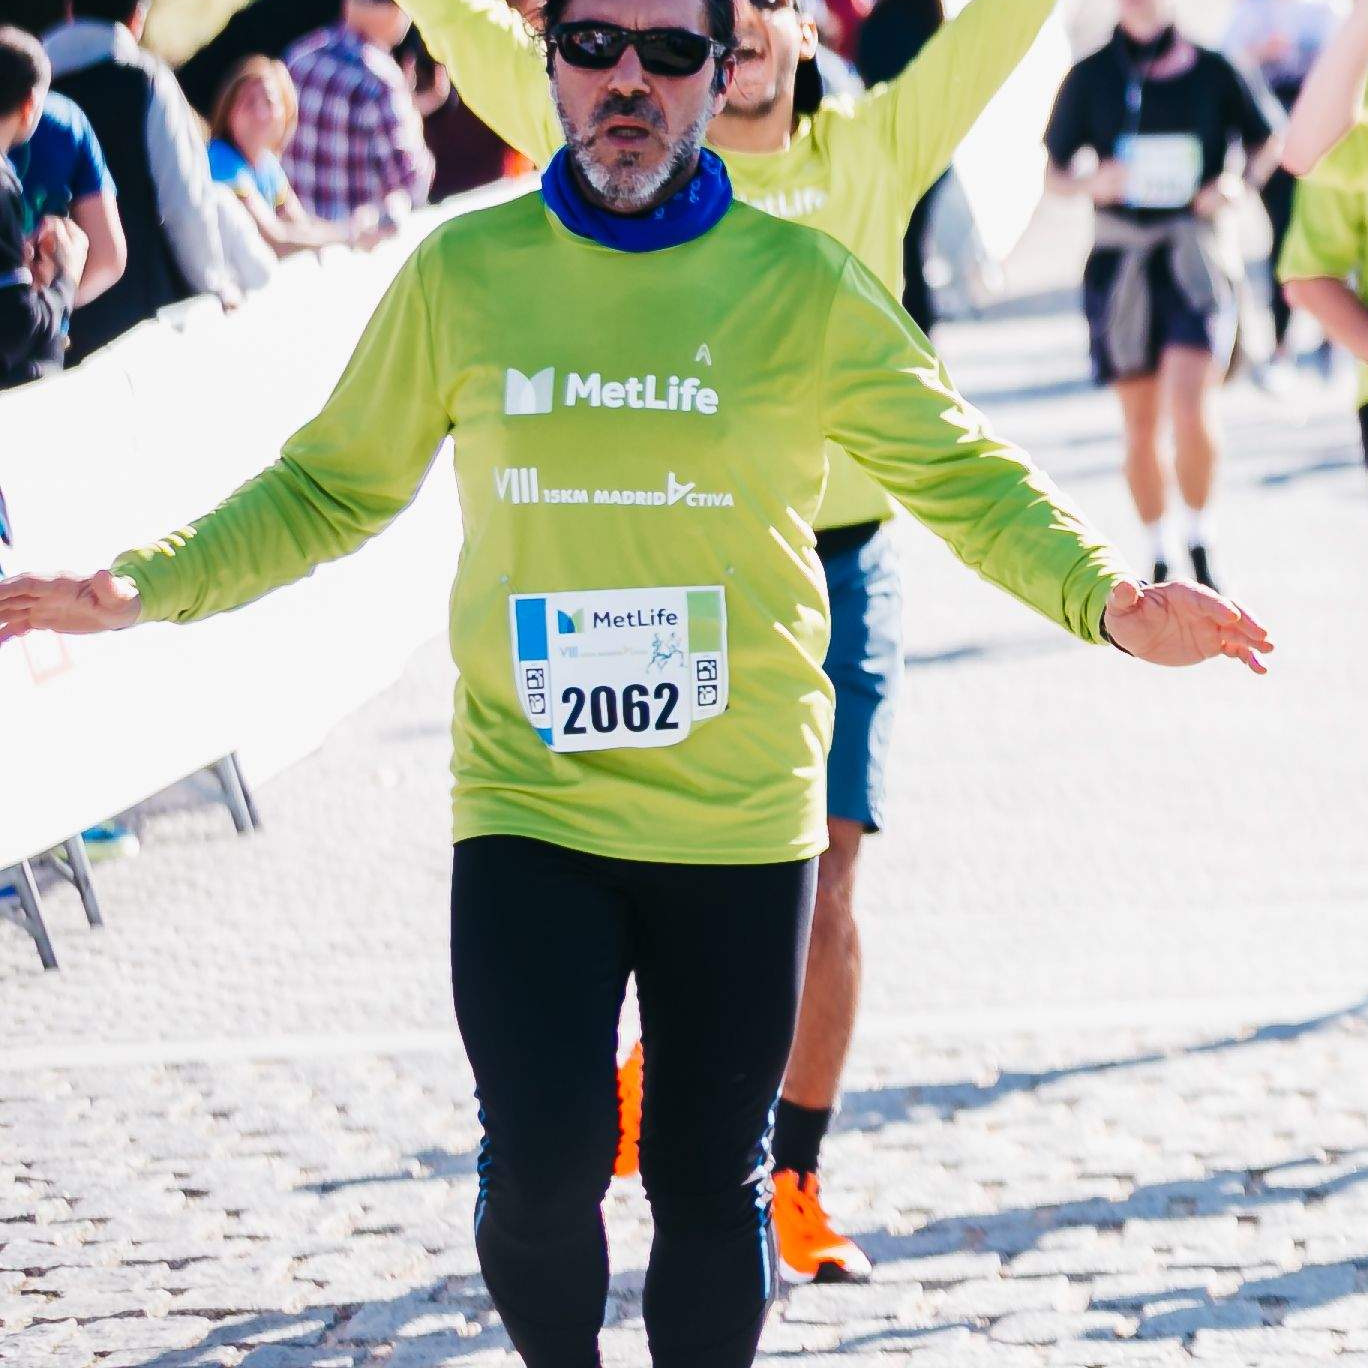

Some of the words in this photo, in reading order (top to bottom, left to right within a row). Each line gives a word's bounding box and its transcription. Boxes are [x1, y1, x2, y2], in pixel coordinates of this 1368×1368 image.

[564, 372, 719, 415] MetLife
[493, 467, 539, 504] VIII
[543, 488, 589, 504] 15KM
[593, 608, 678, 630] MetLife
[561, 682, 679, 735] 2062
